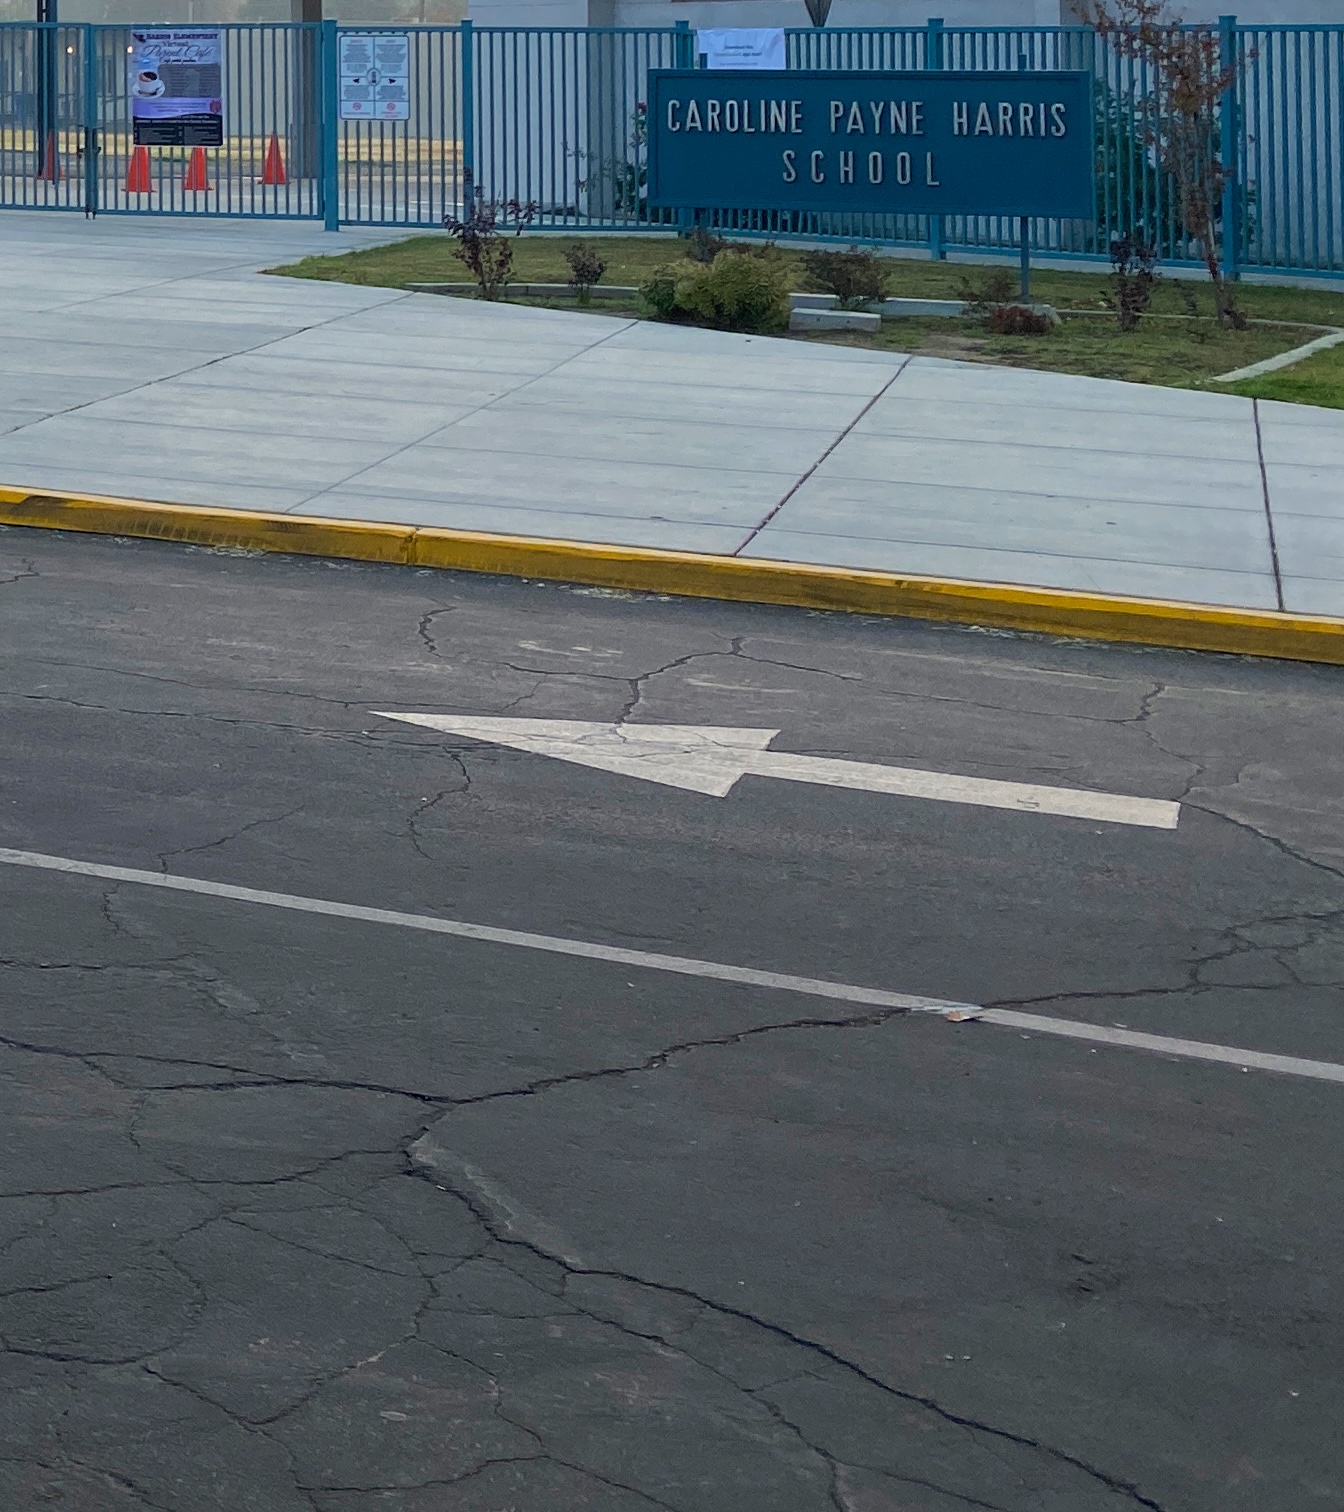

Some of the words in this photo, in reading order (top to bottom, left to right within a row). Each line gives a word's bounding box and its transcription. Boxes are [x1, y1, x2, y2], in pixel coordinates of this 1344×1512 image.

[666, 98, 804, 134] CAROLINE
[829, 100, 925, 136] PAYNE
[952, 100, 1067, 138] HARRIS
[782, 148, 941, 186] SCHOOL
